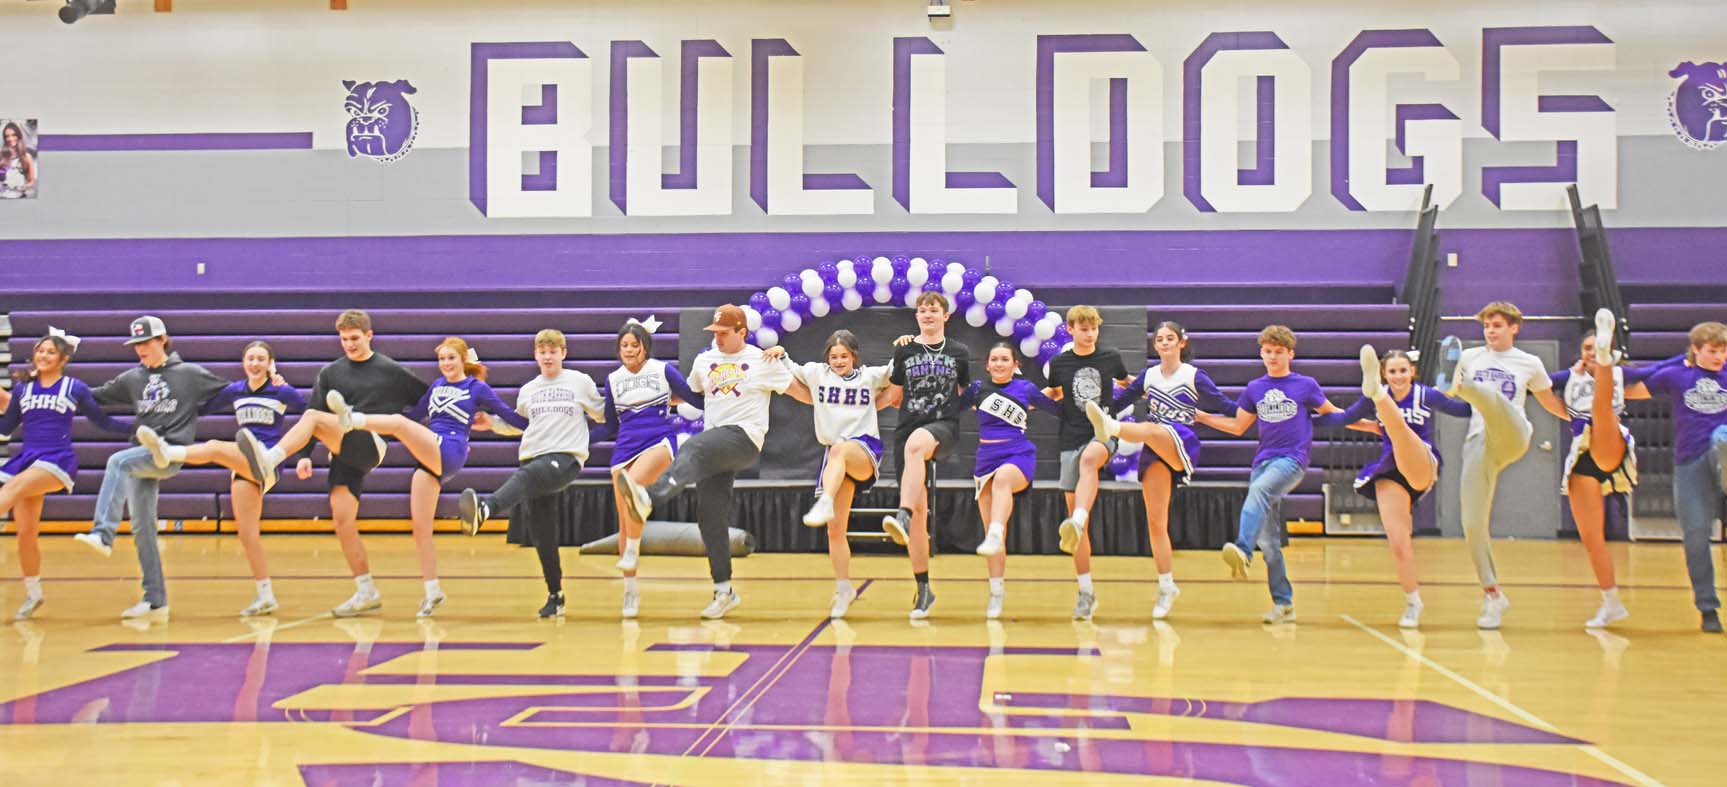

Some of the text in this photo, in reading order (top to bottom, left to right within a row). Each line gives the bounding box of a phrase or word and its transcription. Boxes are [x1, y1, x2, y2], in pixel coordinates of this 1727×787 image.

[469, 26, 1617, 217] BULLDOGS
[904, 353, 957, 368] BLACK
[615, 374, 661, 398] DOGS
[818, 386, 870, 406] SHHS
[20, 394, 72, 415] SHHS
[531, 406, 575, 418] BULLDOGS
[990, 399, 1025, 425] SHS
